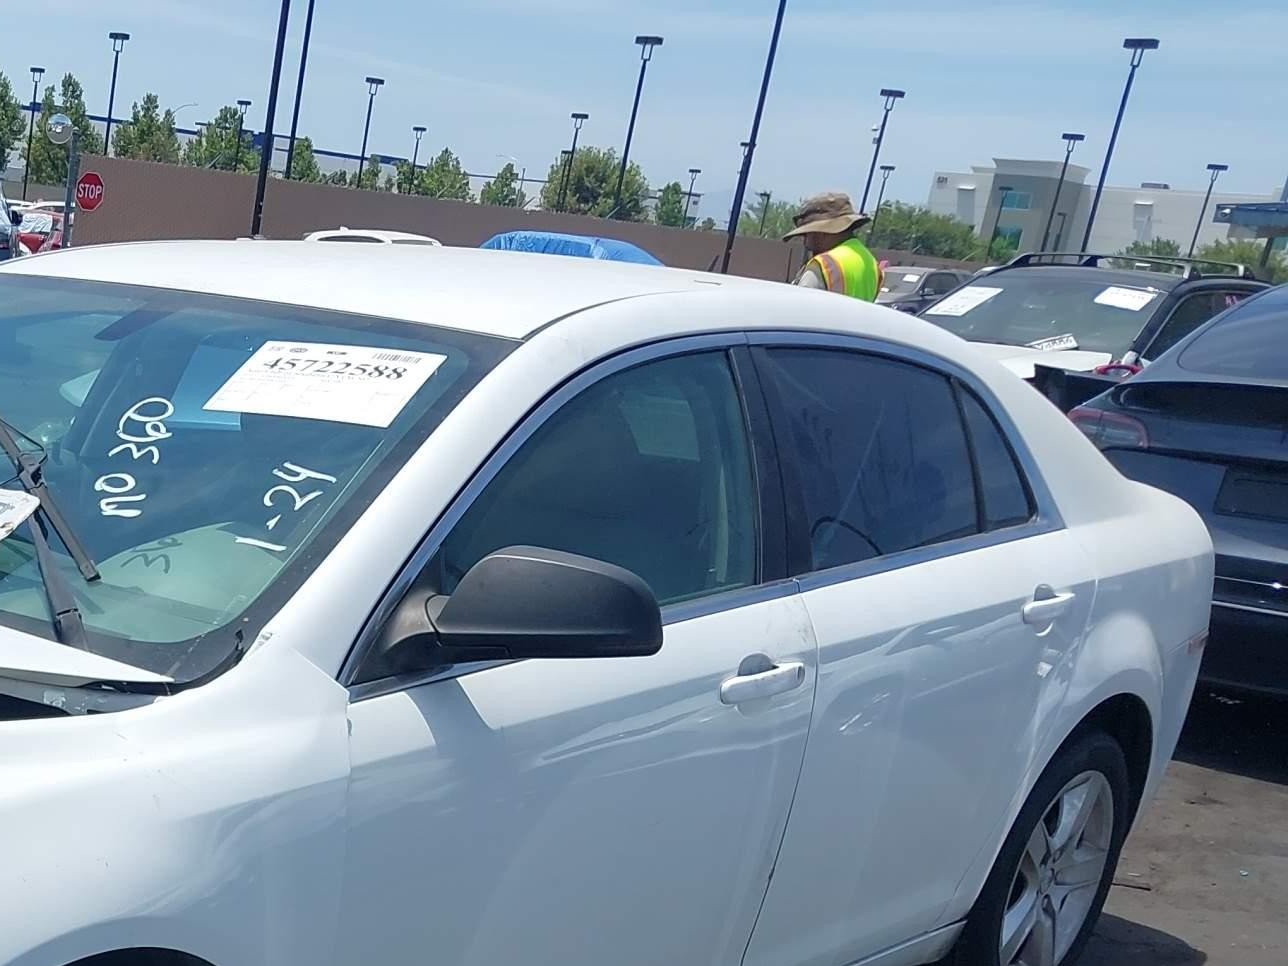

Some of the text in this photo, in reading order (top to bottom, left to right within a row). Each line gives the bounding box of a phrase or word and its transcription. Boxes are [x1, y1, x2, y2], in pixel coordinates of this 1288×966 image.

[77, 183, 103, 199] STOP
[263, 356, 409, 382] 45722588
[107, 397, 175, 465] 360
[234, 460, 338, 552] 1-24
